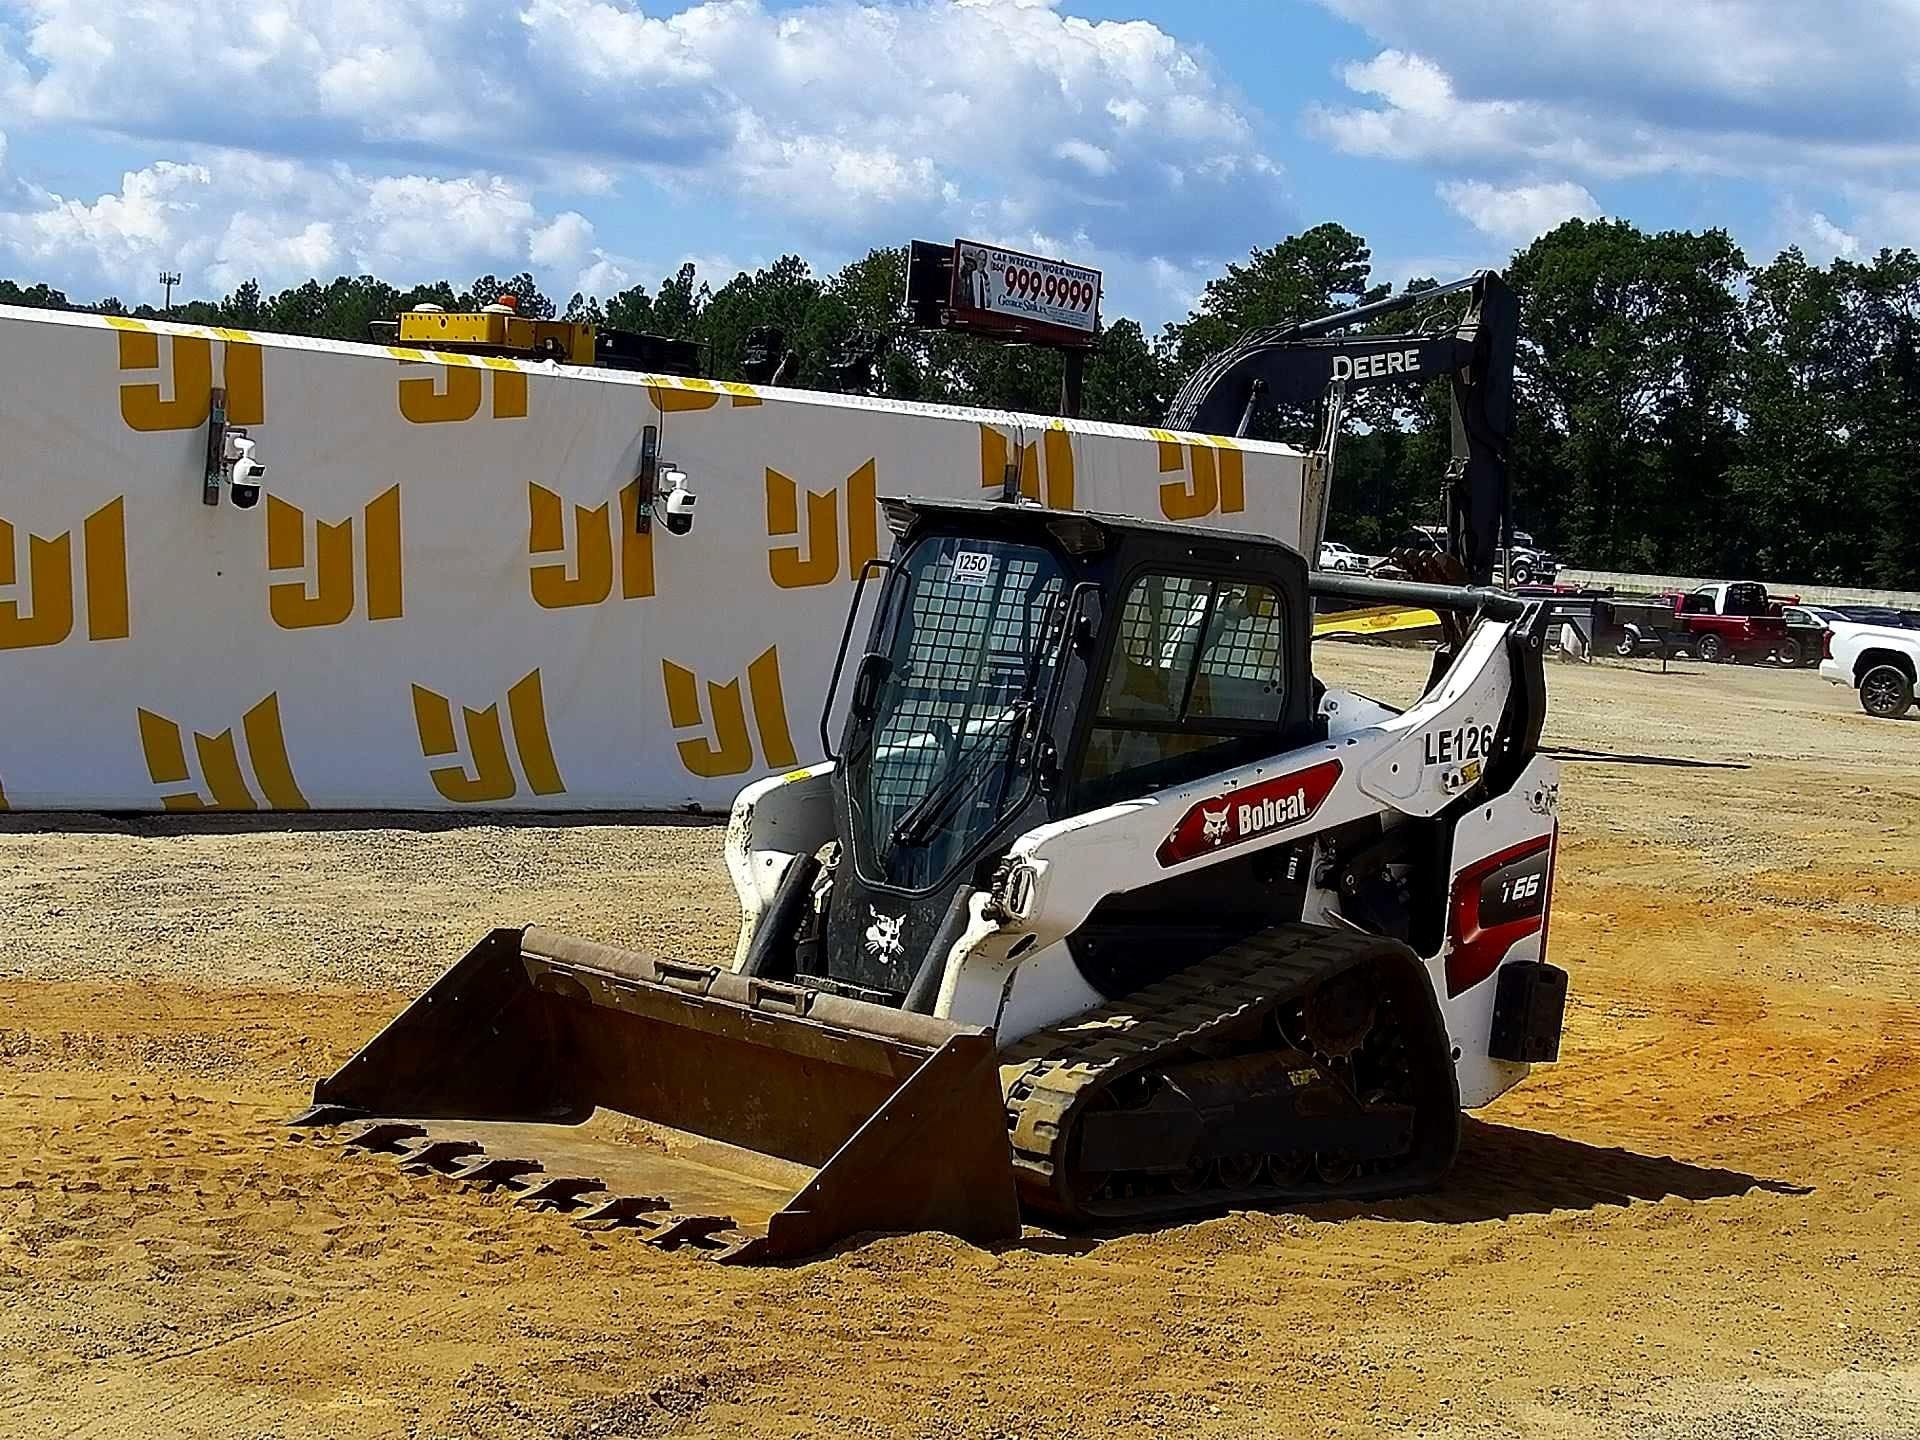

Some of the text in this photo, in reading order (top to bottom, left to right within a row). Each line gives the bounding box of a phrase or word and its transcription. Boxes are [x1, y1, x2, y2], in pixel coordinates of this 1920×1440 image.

[1331, 348, 1421, 381] DEERE
[959, 554, 988, 572] 1250
[1424, 724, 1494, 766] LE126
[1238, 788, 1307, 836] Bobcat
